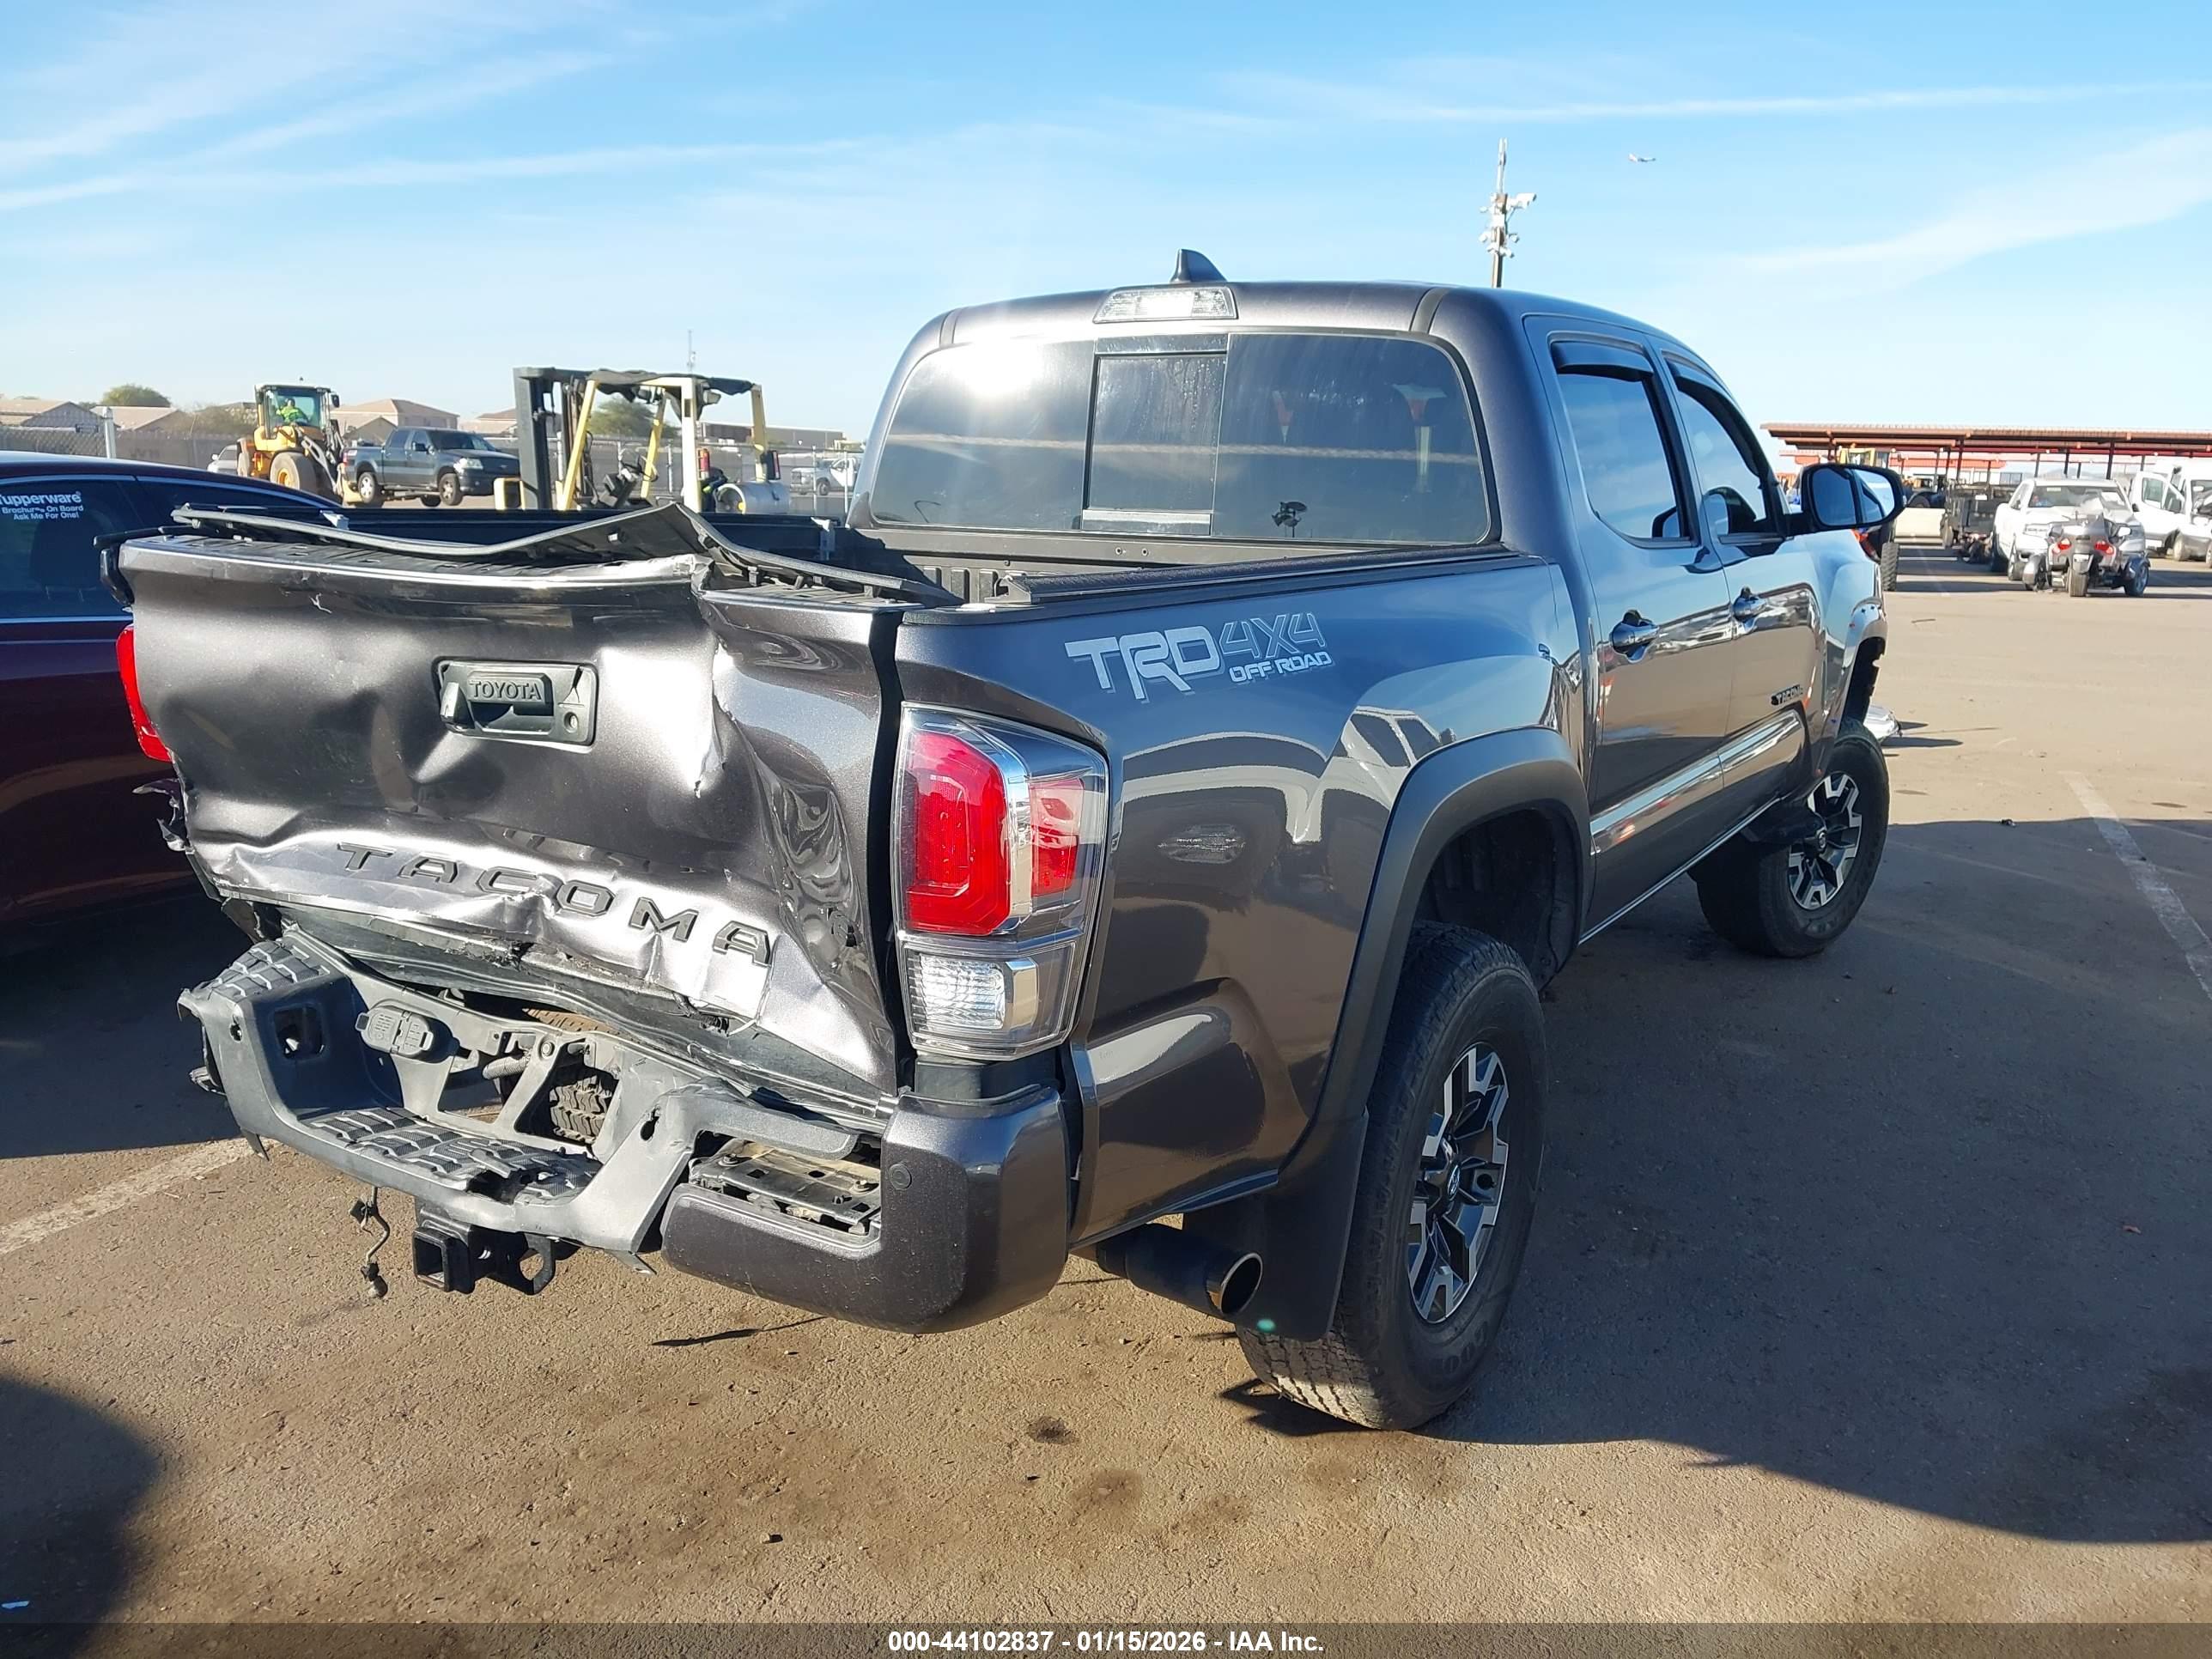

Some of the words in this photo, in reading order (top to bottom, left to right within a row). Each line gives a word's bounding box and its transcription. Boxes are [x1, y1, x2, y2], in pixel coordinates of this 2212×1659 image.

[1064, 626, 1223, 700] TRD
[1229, 660, 1273, 683] OFF
[1277, 651, 1332, 674] ROAD
[470, 680, 542, 700] TOYOTA
[337, 842, 773, 968] TACOMA
